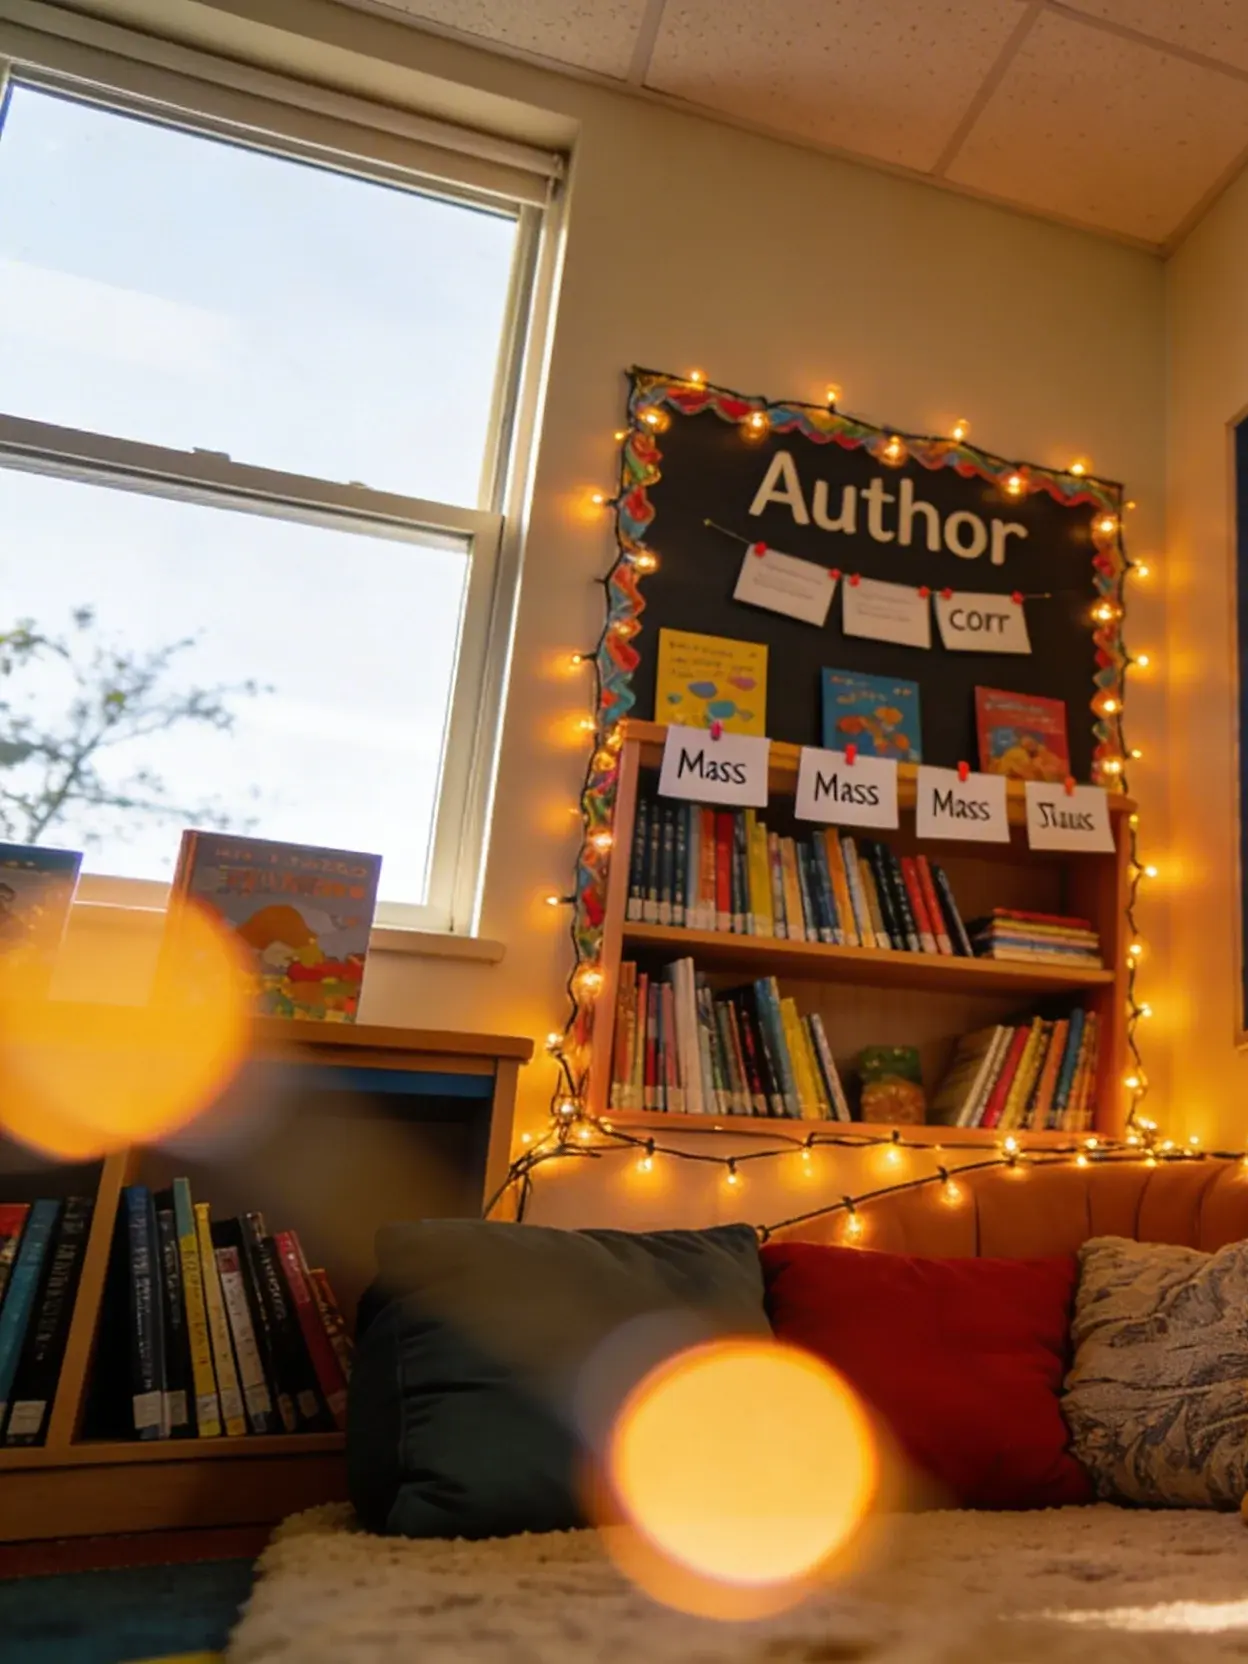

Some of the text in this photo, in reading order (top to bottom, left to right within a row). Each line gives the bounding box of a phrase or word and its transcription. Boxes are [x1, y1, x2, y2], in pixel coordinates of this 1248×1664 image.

[749, 451, 1028, 565] Author
[677, 748, 748, 786] Mass
[813, 769, 881, 806] Mass
[932, 790, 991, 823] Mass
